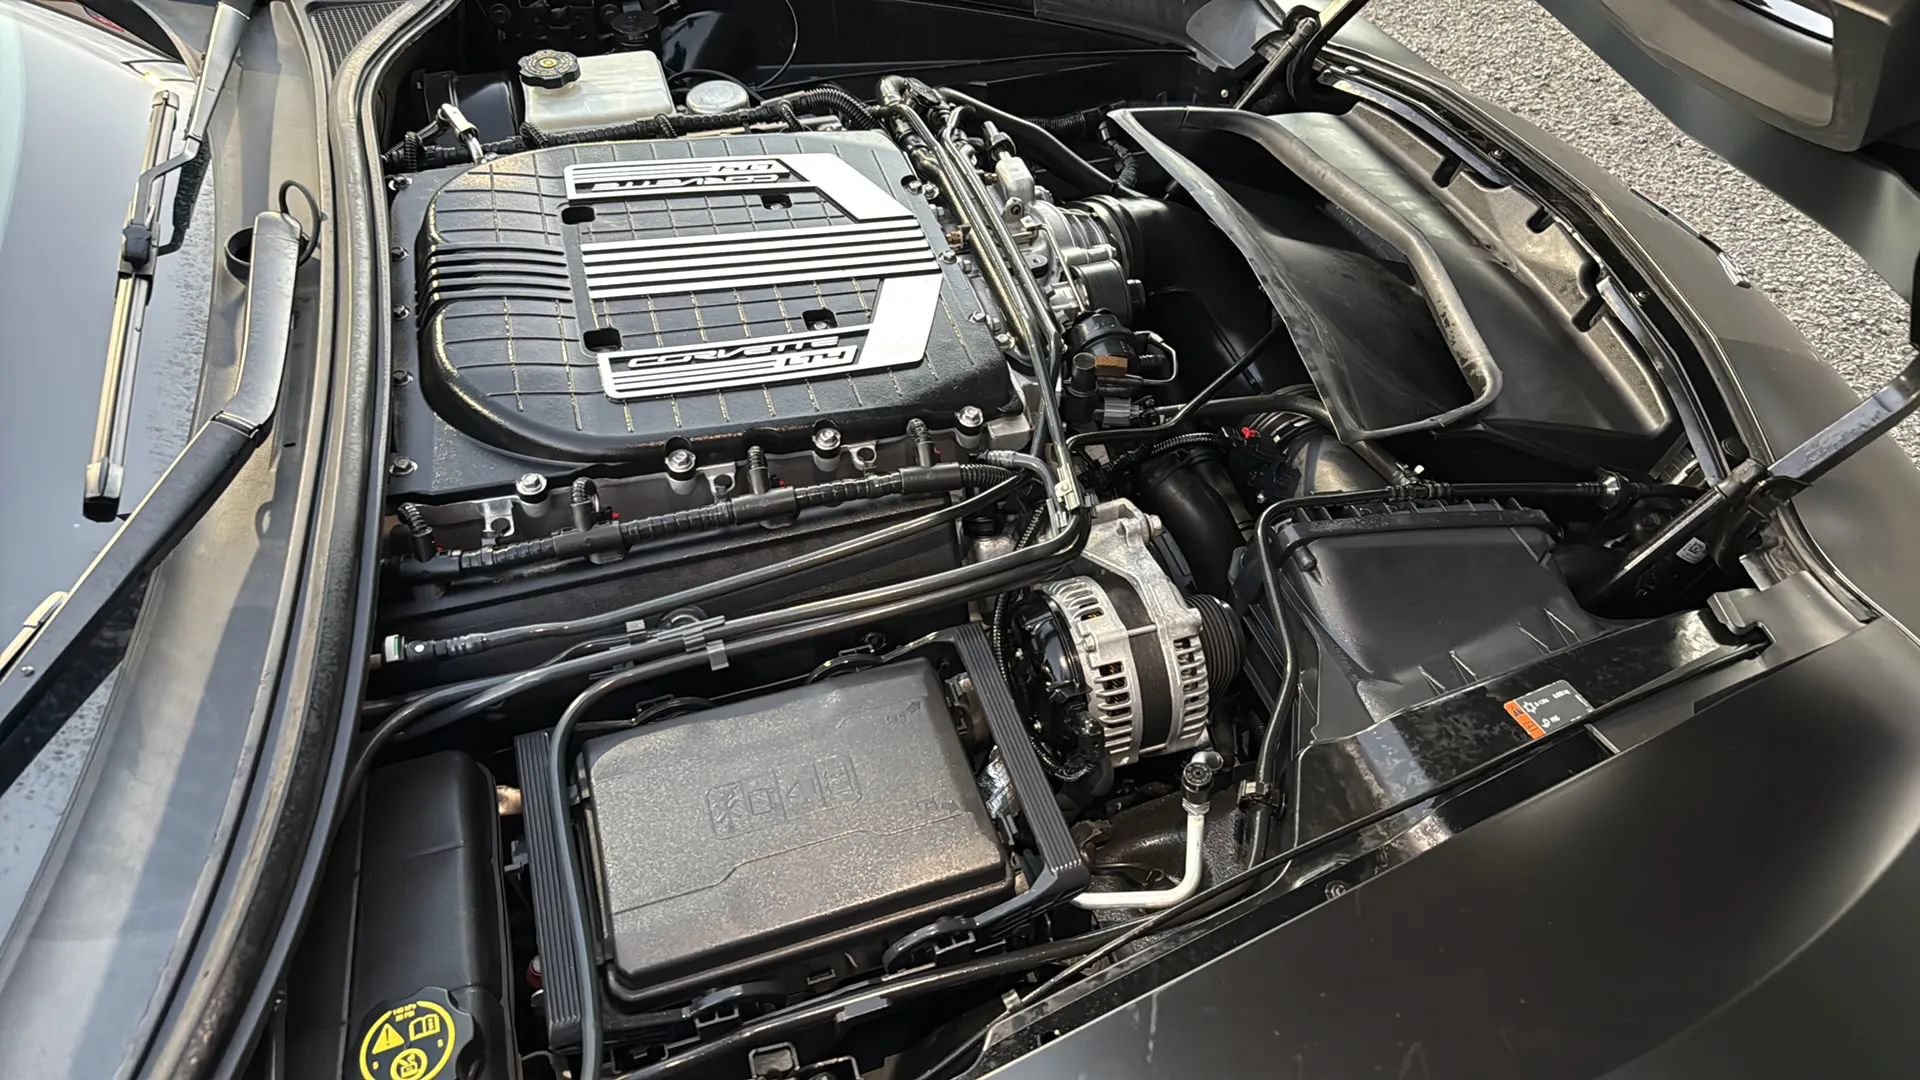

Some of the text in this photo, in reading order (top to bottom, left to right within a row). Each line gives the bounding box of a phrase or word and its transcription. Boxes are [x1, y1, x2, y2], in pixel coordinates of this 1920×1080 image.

[718, 163, 774, 172] LT4
[591, 173, 780, 191] CORVETTE
[628, 336, 840, 368] CORVETTE
[784, 350, 846, 367] LT4
